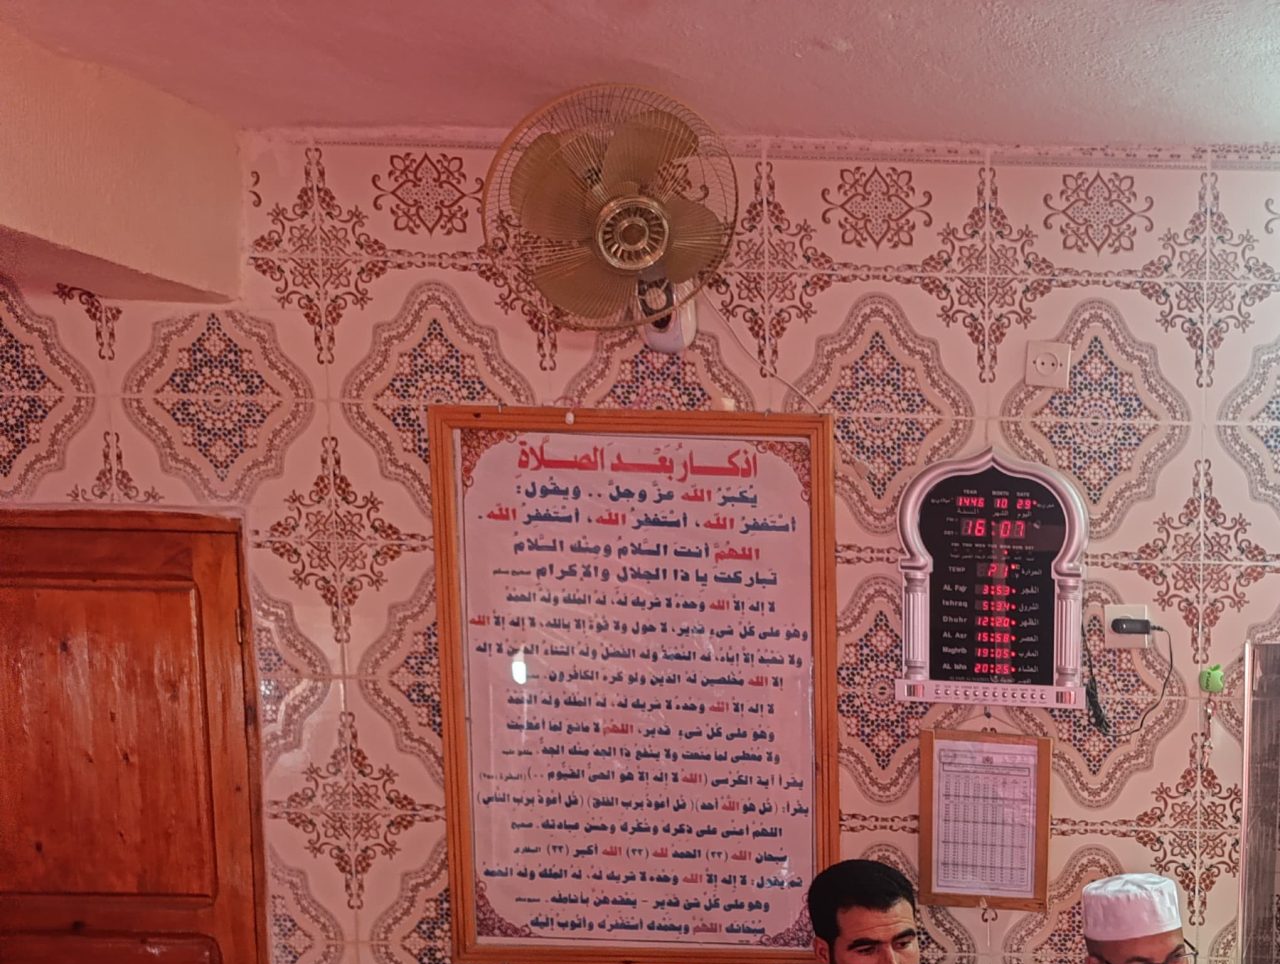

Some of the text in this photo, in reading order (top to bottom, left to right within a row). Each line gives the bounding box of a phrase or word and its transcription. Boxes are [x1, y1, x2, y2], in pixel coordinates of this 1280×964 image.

[958, 496, 985, 507] 1446
[995, 498, 1008, 509] 10
[1016, 499, 1031, 509] 29
[966, 518, 1025, 538] 16:07
[982, 584, 1010, 595] 3:53
[1021, 585, 1040, 594] الفجر
[710, 599, 730, 611] الله
[469, 615, 490, 627] الله
[977, 616, 1010, 627] 12:20
